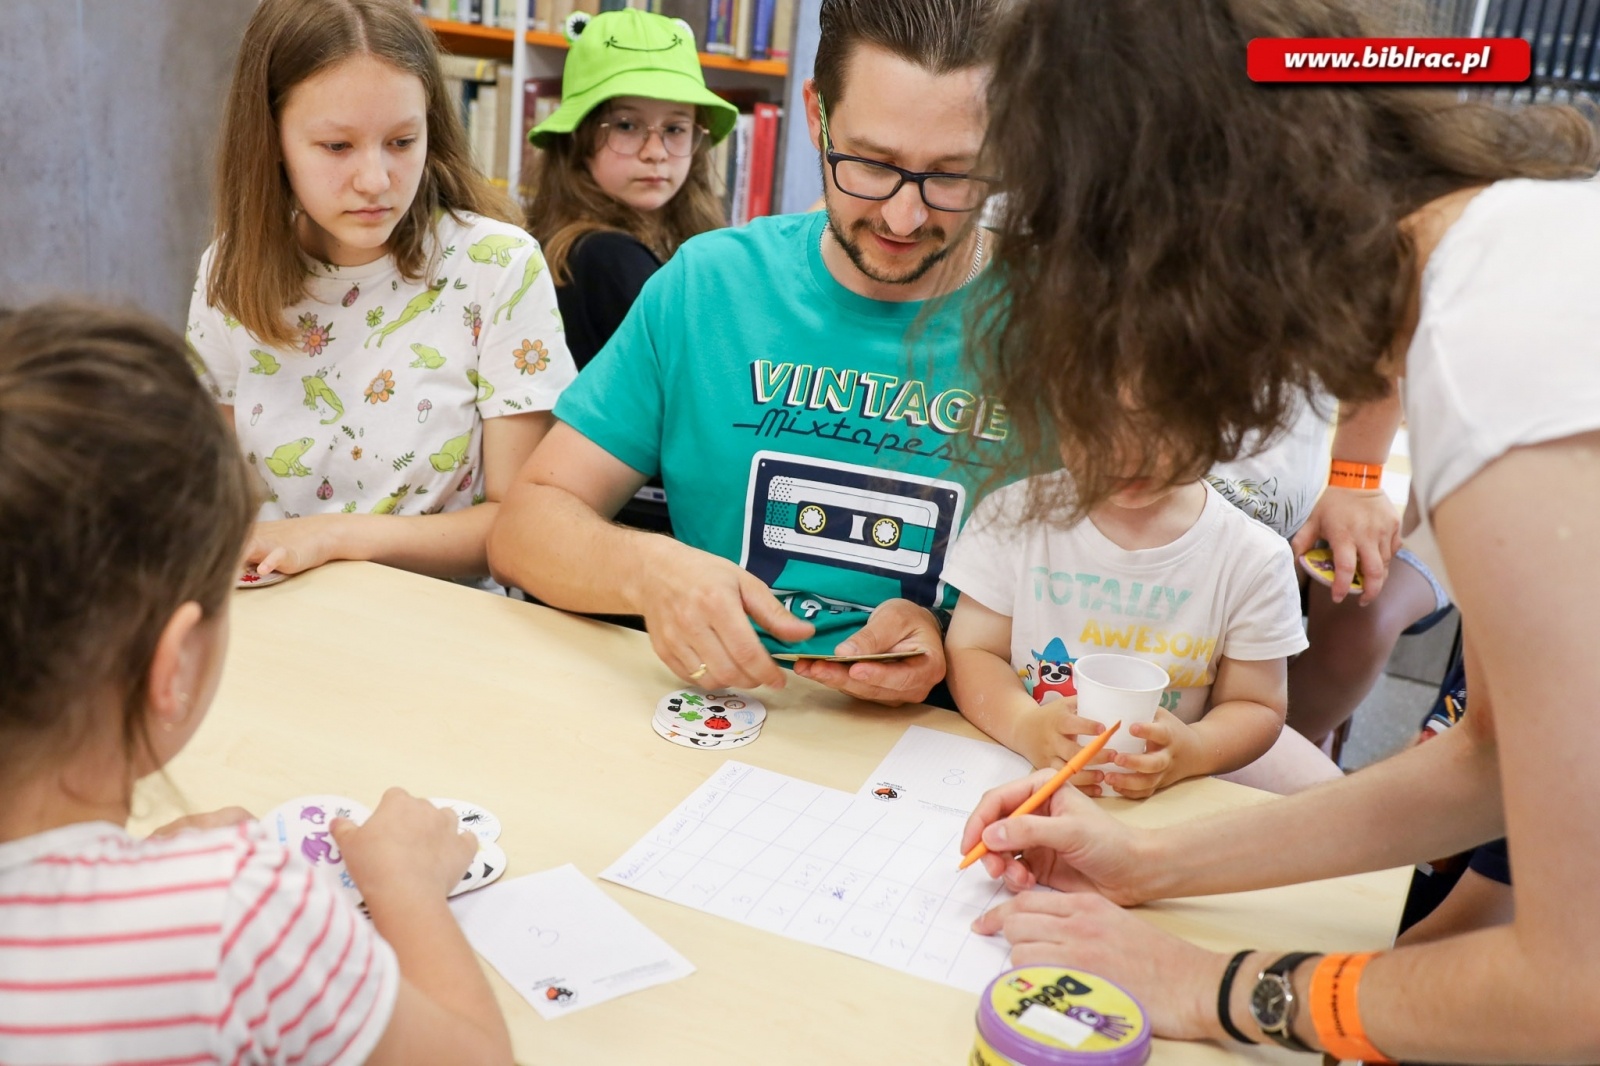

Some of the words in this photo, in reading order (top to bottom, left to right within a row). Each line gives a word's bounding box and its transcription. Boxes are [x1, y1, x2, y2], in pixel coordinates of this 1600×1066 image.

[751, 359, 1008, 442] VINTAGE
[738, 408, 975, 462] Mixtapes
[1030, 566, 1192, 621] TOTALLY
[942, 768, 966, 786] 8
[528, 925, 560, 948] 3
